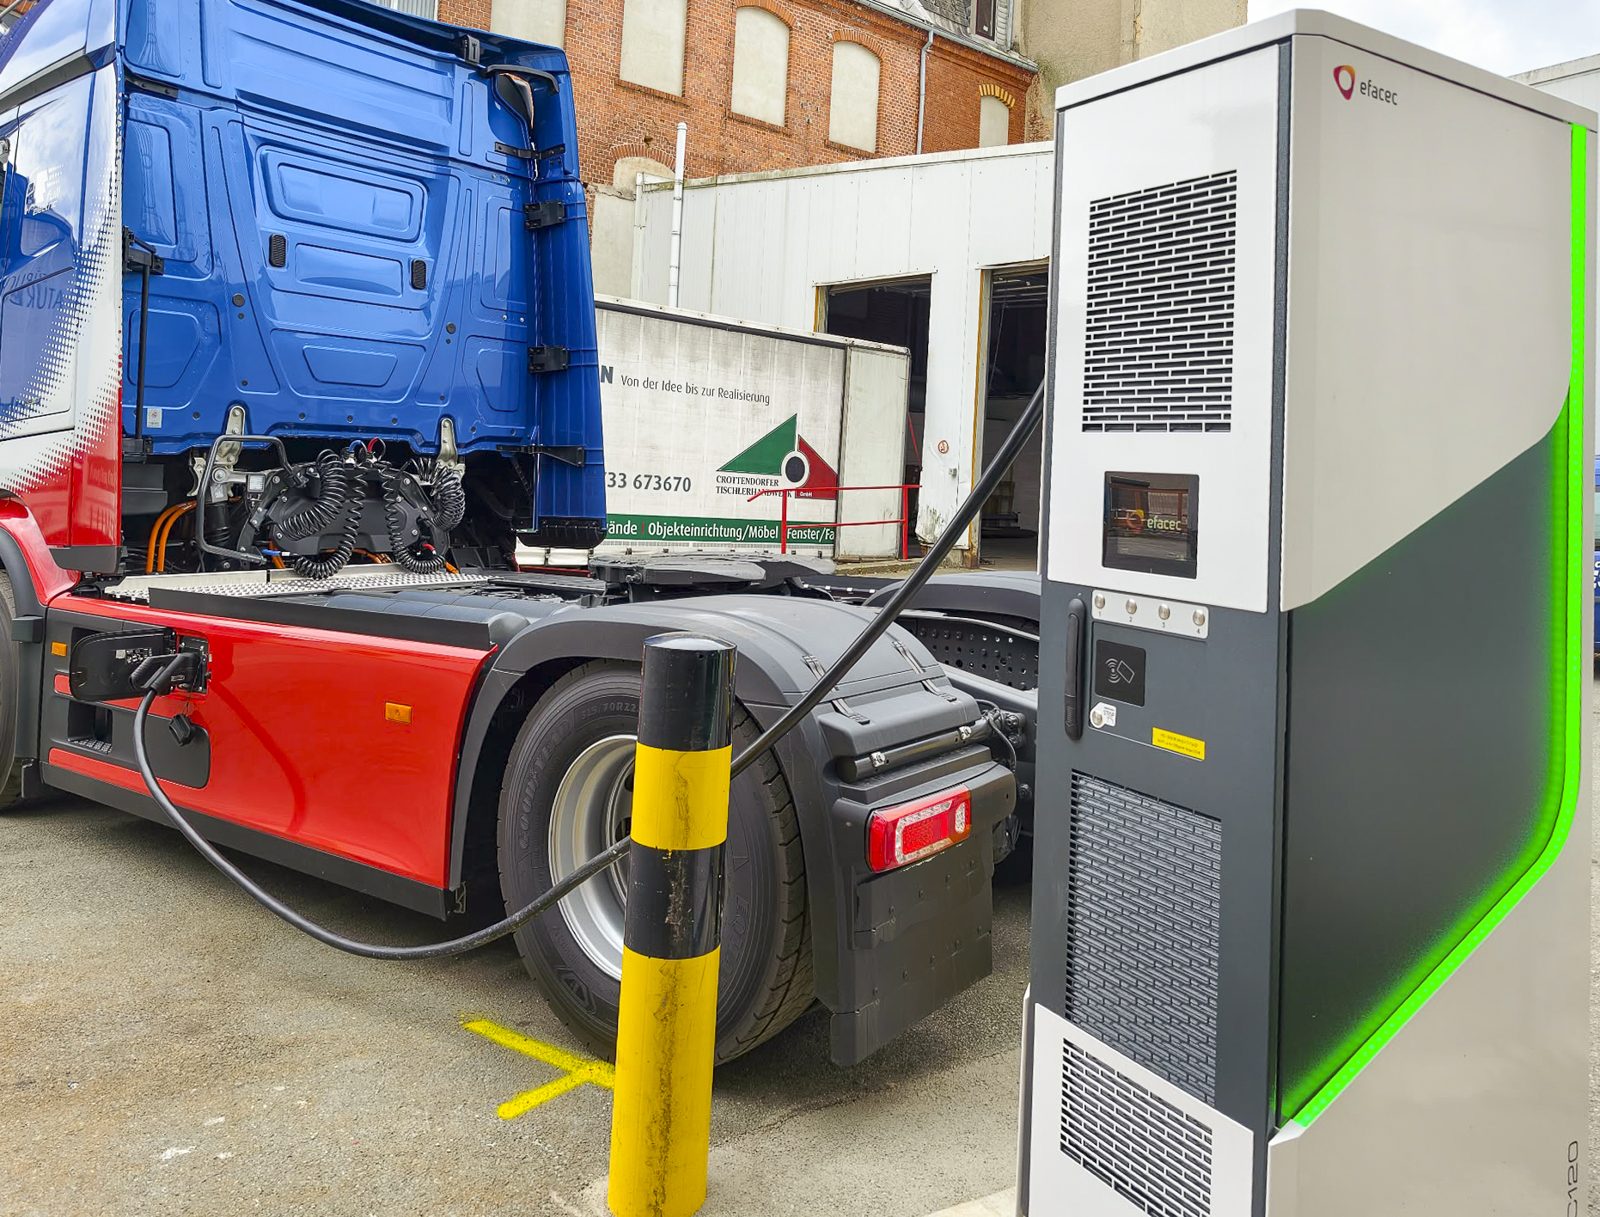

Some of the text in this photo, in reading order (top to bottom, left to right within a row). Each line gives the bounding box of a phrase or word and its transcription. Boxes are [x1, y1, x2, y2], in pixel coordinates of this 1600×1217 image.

[1360, 80, 1397, 105] efacec
[621, 375, 639, 388] Von
[642, 377, 658, 390] der
[661, 379, 682, 393] Idee
[685, 382, 698, 395] bis
[701, 387, 715, 397] zur
[718, 387, 770, 406] Realisierung
[605, 472, 692, 492] 33 673670
[716, 475, 779, 487] CROTTENDORFER
[607, 520, 638, 535] ände
[648, 521, 779, 541] Objekteinrichtung/Möbel
[1147, 515, 1181, 530] efacec
